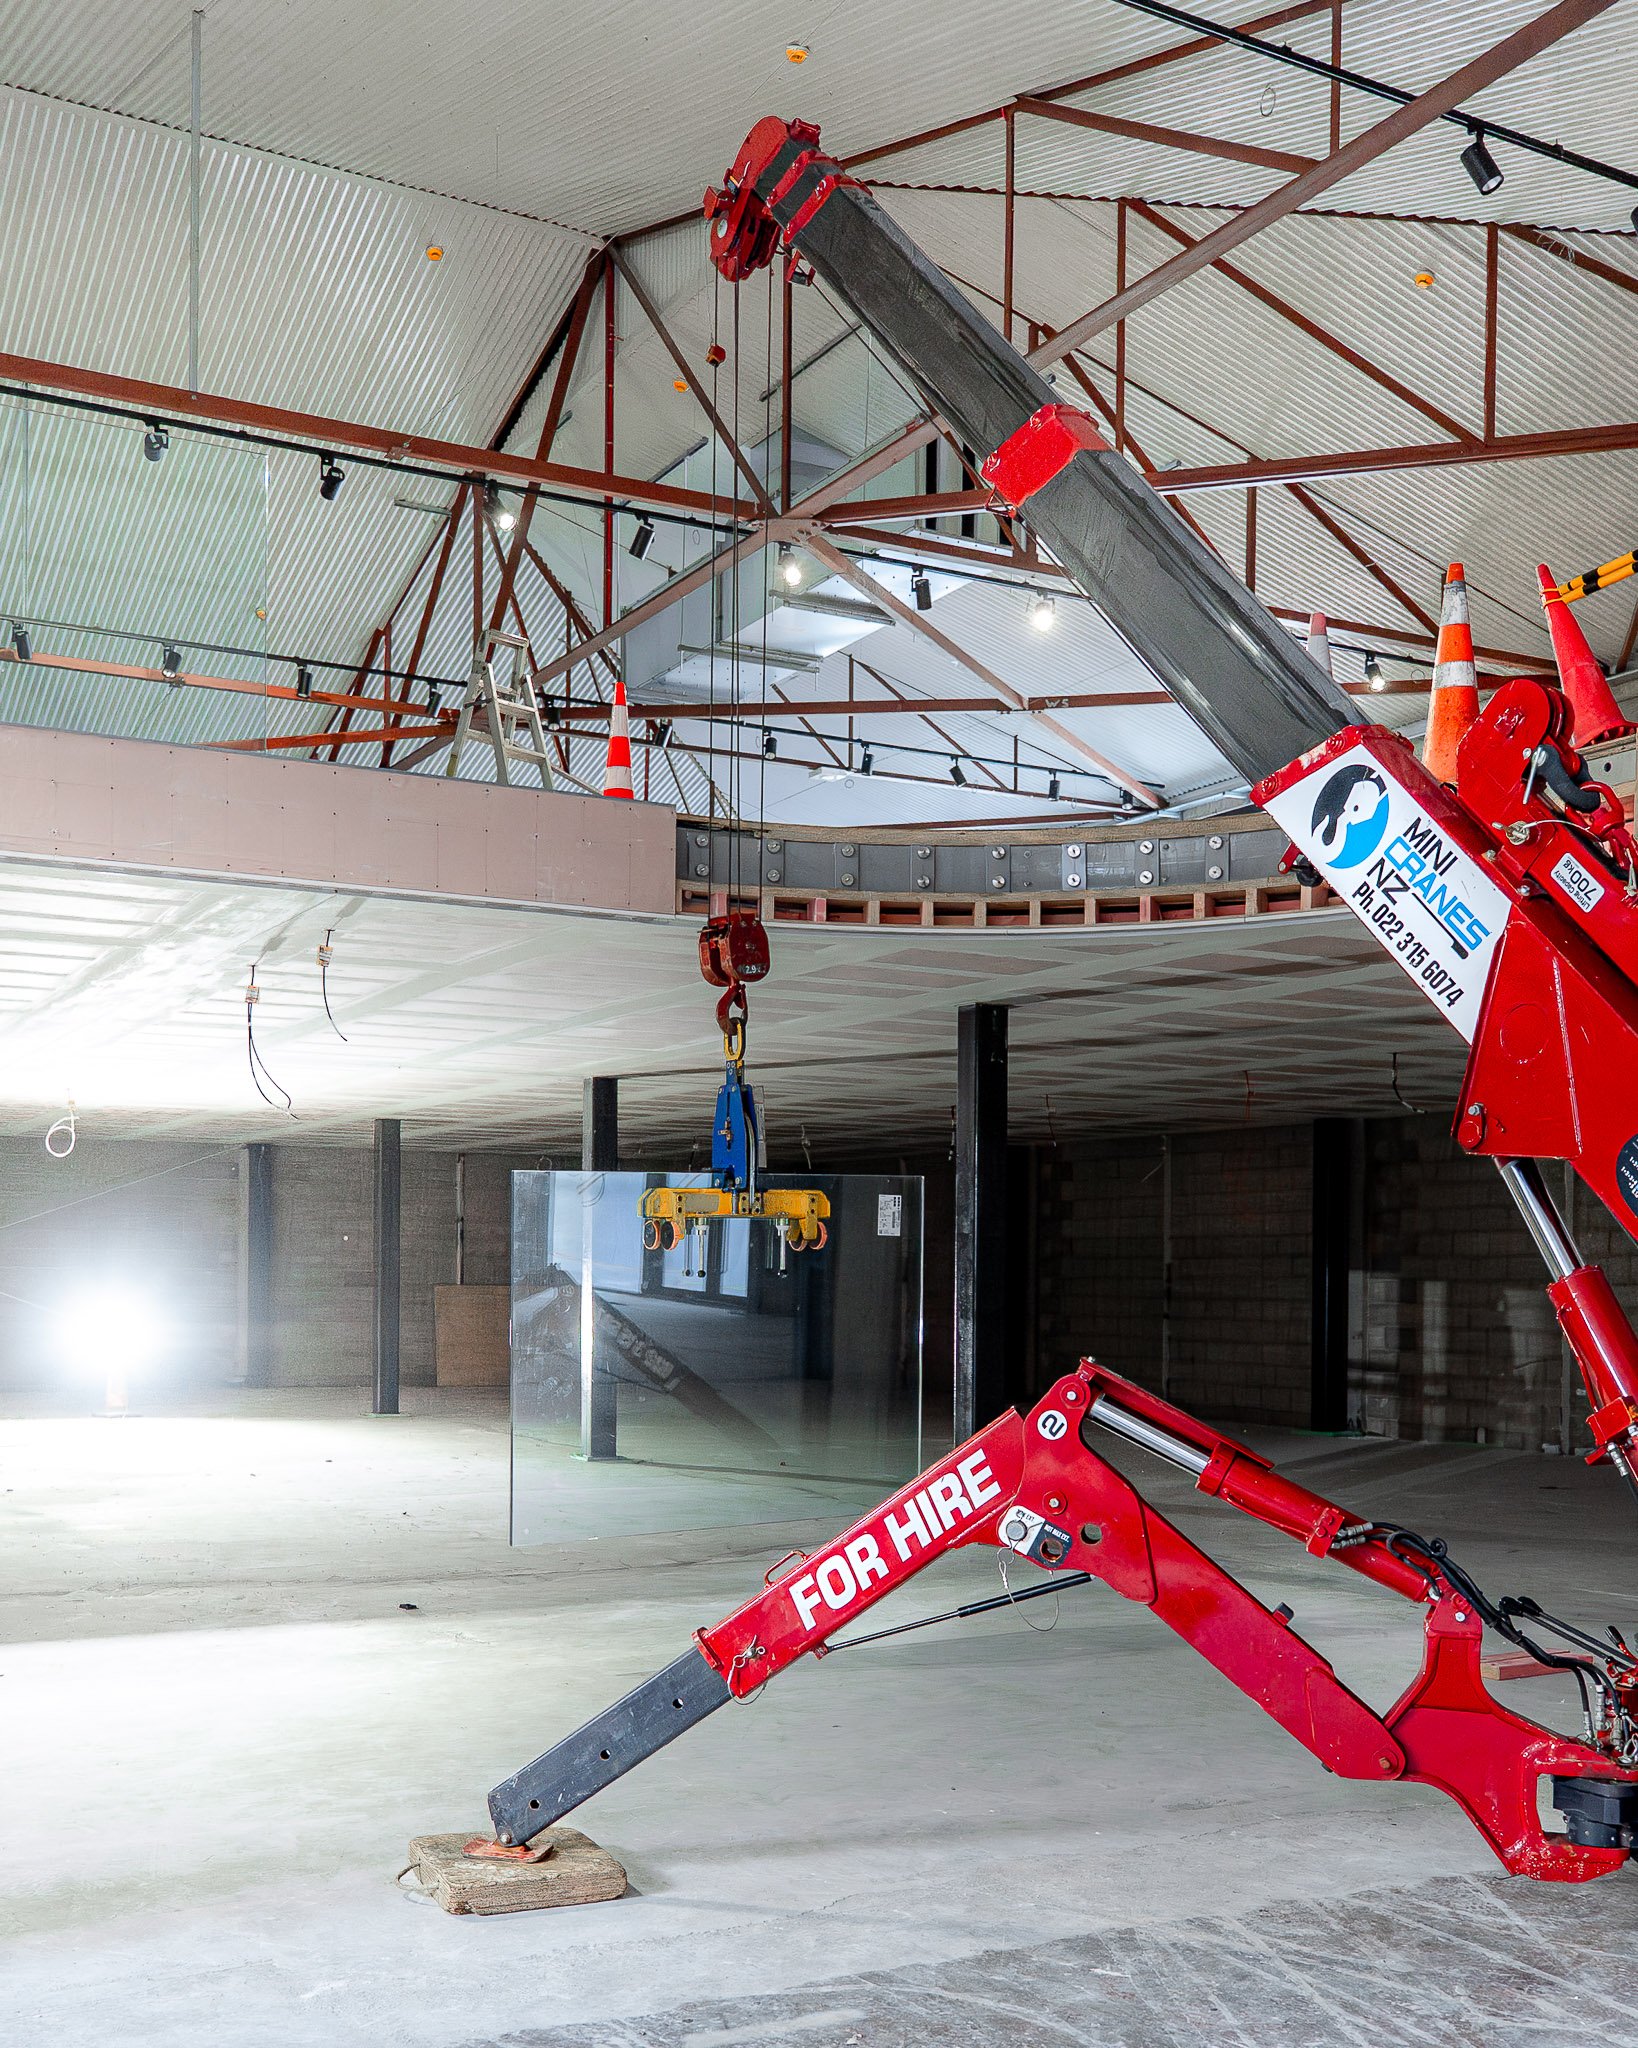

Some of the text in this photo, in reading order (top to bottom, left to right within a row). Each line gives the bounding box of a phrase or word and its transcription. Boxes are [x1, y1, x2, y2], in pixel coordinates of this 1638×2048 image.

[1403, 816, 1458, 877] MINI
[1366, 857, 1411, 906] NZ
[1554, 870, 1575, 894] Capacity
[1563, 859, 1575, 875] kg
[1570, 870, 1597, 901] 700
[1384, 836, 1491, 951] CRANES
[1574, 890, 1590, 910] Lifting
[1351, 881, 1465, 1008] Ph. 022 315 6074
[1040, 1413, 1065, 1438] 2
[788, 1447, 1002, 1632] FOR HIRE
